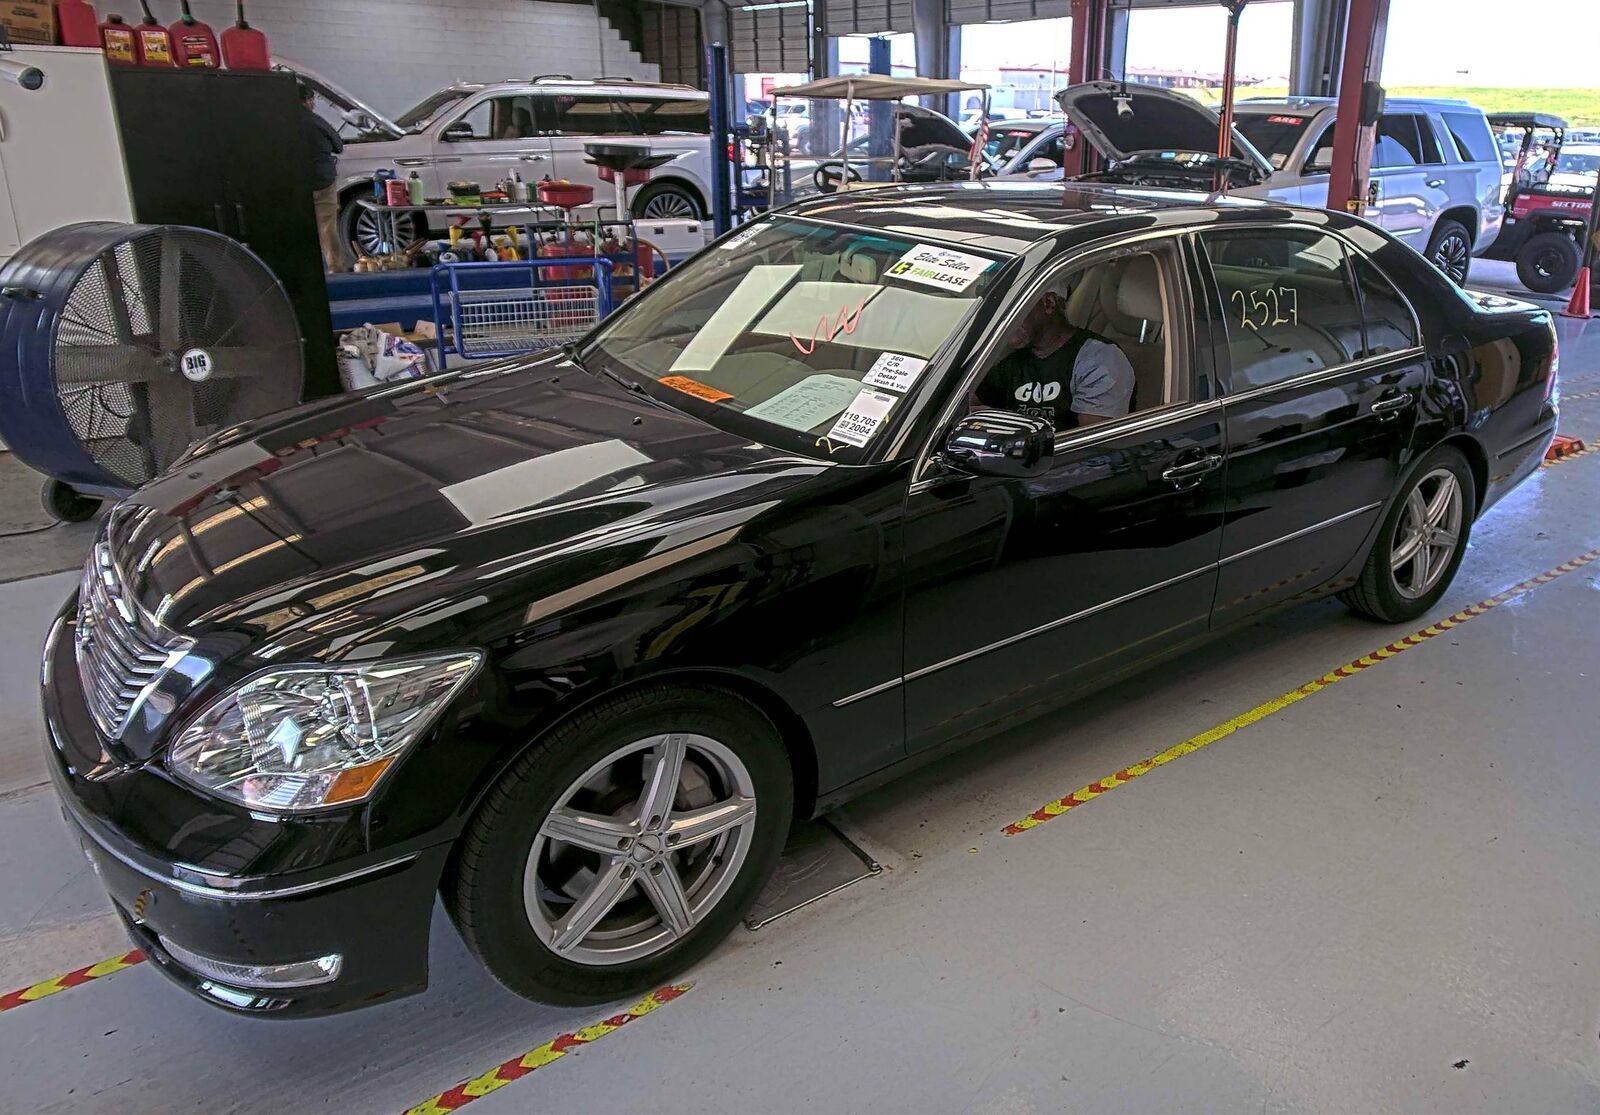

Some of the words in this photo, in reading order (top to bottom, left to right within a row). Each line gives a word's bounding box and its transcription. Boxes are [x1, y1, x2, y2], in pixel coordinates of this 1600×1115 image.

[1551, 201, 1593, 209] SECTOR
[913, 252, 939, 264] Elite
[938, 259, 970, 271] Seller
[910, 268, 969, 286] FAIRLEASE
[1231, 286, 1298, 330] 2527
[185, 354, 207, 370] BIG
[877, 372, 898, 381] Detail
[881, 366, 908, 377] Pre-Sale
[874, 378, 890, 386] Wash
[1014, 381, 1061, 403] GOD
[849, 422, 872, 435] 2004
